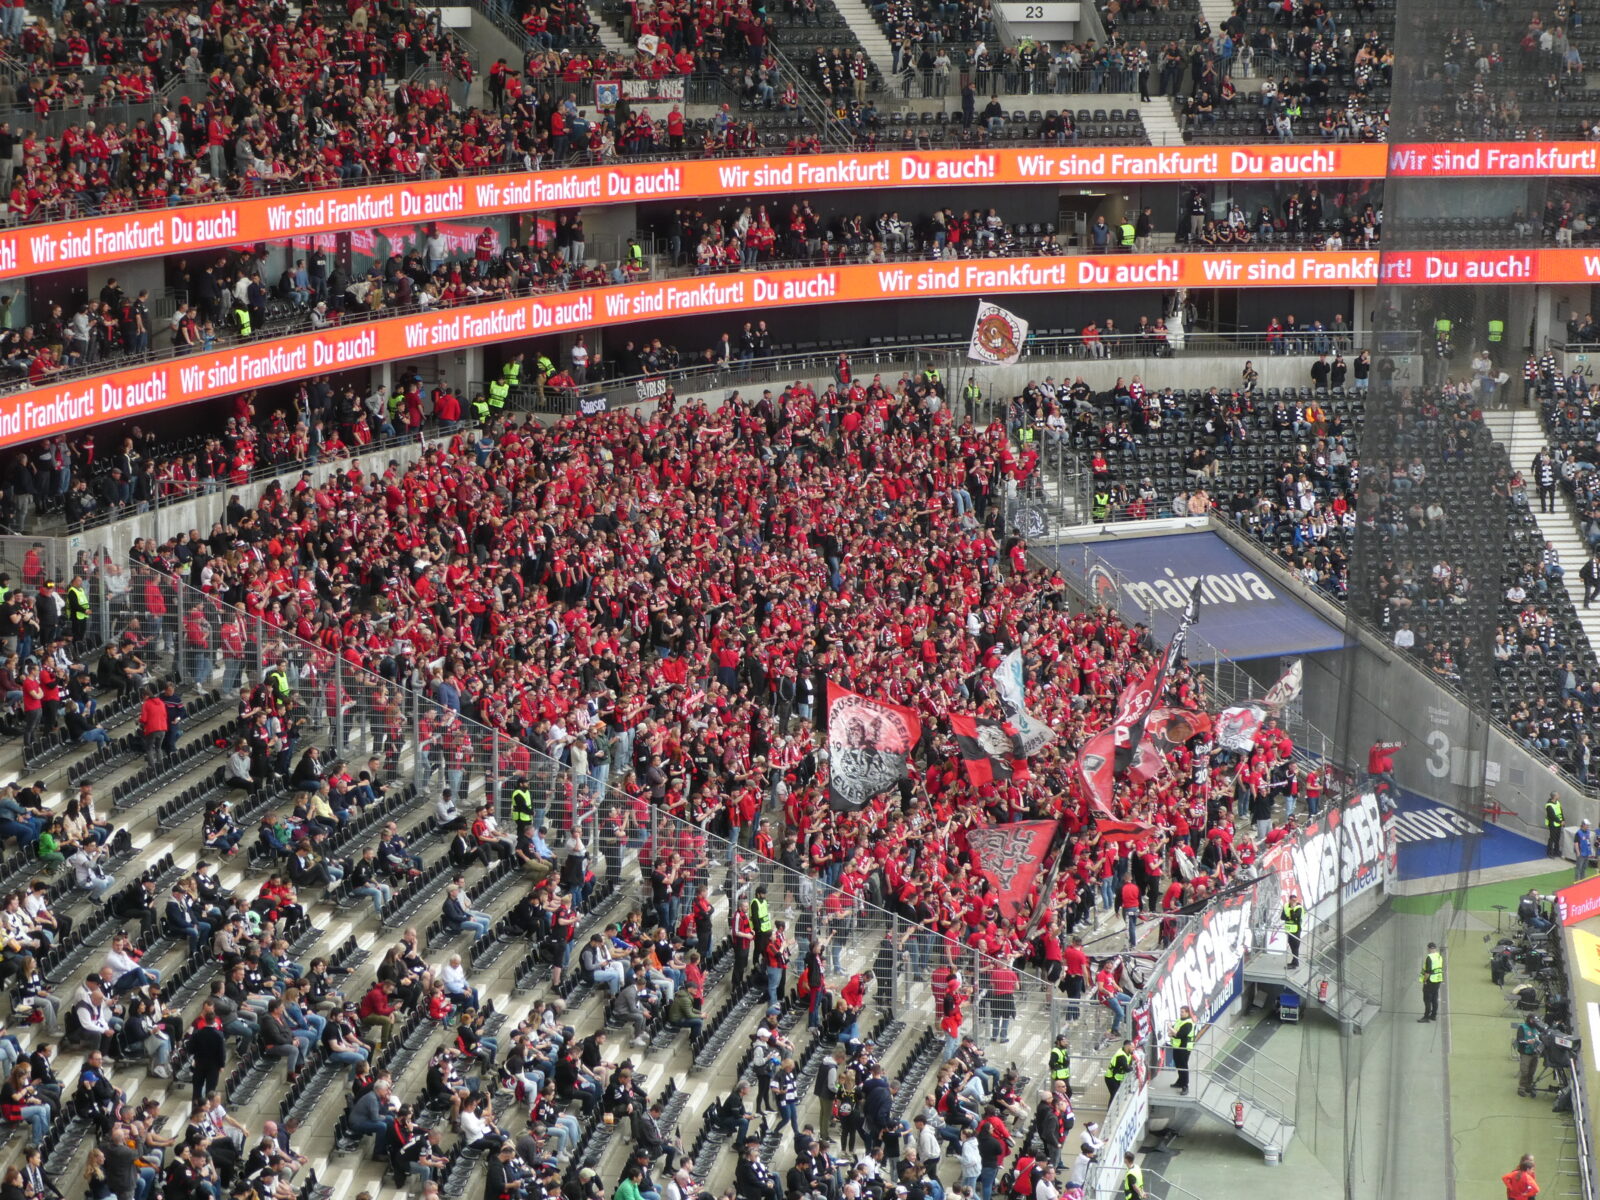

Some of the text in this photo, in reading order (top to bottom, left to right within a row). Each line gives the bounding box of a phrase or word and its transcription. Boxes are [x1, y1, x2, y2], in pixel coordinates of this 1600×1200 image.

[1026, 6, 1044, 19] 23
[719, 155, 994, 188] Wir sind Frankfurt! Du auch!
[1017, 150, 1334, 176] Wir sind Frankfurt! Du auch!
[1390, 148, 1595, 170] Wir sind Frankfurt!
[268, 186, 463, 231] Wir sind Frankfurt! Du auch!
[476, 168, 680, 207] Wir sind Frankfurt! Du auch!
[31, 210, 236, 264] Wir sind Frankfurt! Du auch!
[878, 259, 1178, 292] Wir sind Frankfurt! Du auch!
[1203, 256, 1531, 281] Wir sind Frankfurt! Du auch!
[605, 273, 835, 317] Wir sind Frankfurt! Du auch!
[405, 297, 592, 348] Wir sind Frankfurt! Du auch!
[180, 330, 375, 393] Wir sind Frankfurt! Du auch!
[24, 388, 94, 430] Frankfurt!
[102, 384, 122, 413] Du
[126, 371, 166, 407] auch!
[1122, 567, 1276, 611] mainova
[1425, 730, 1450, 778] 3
